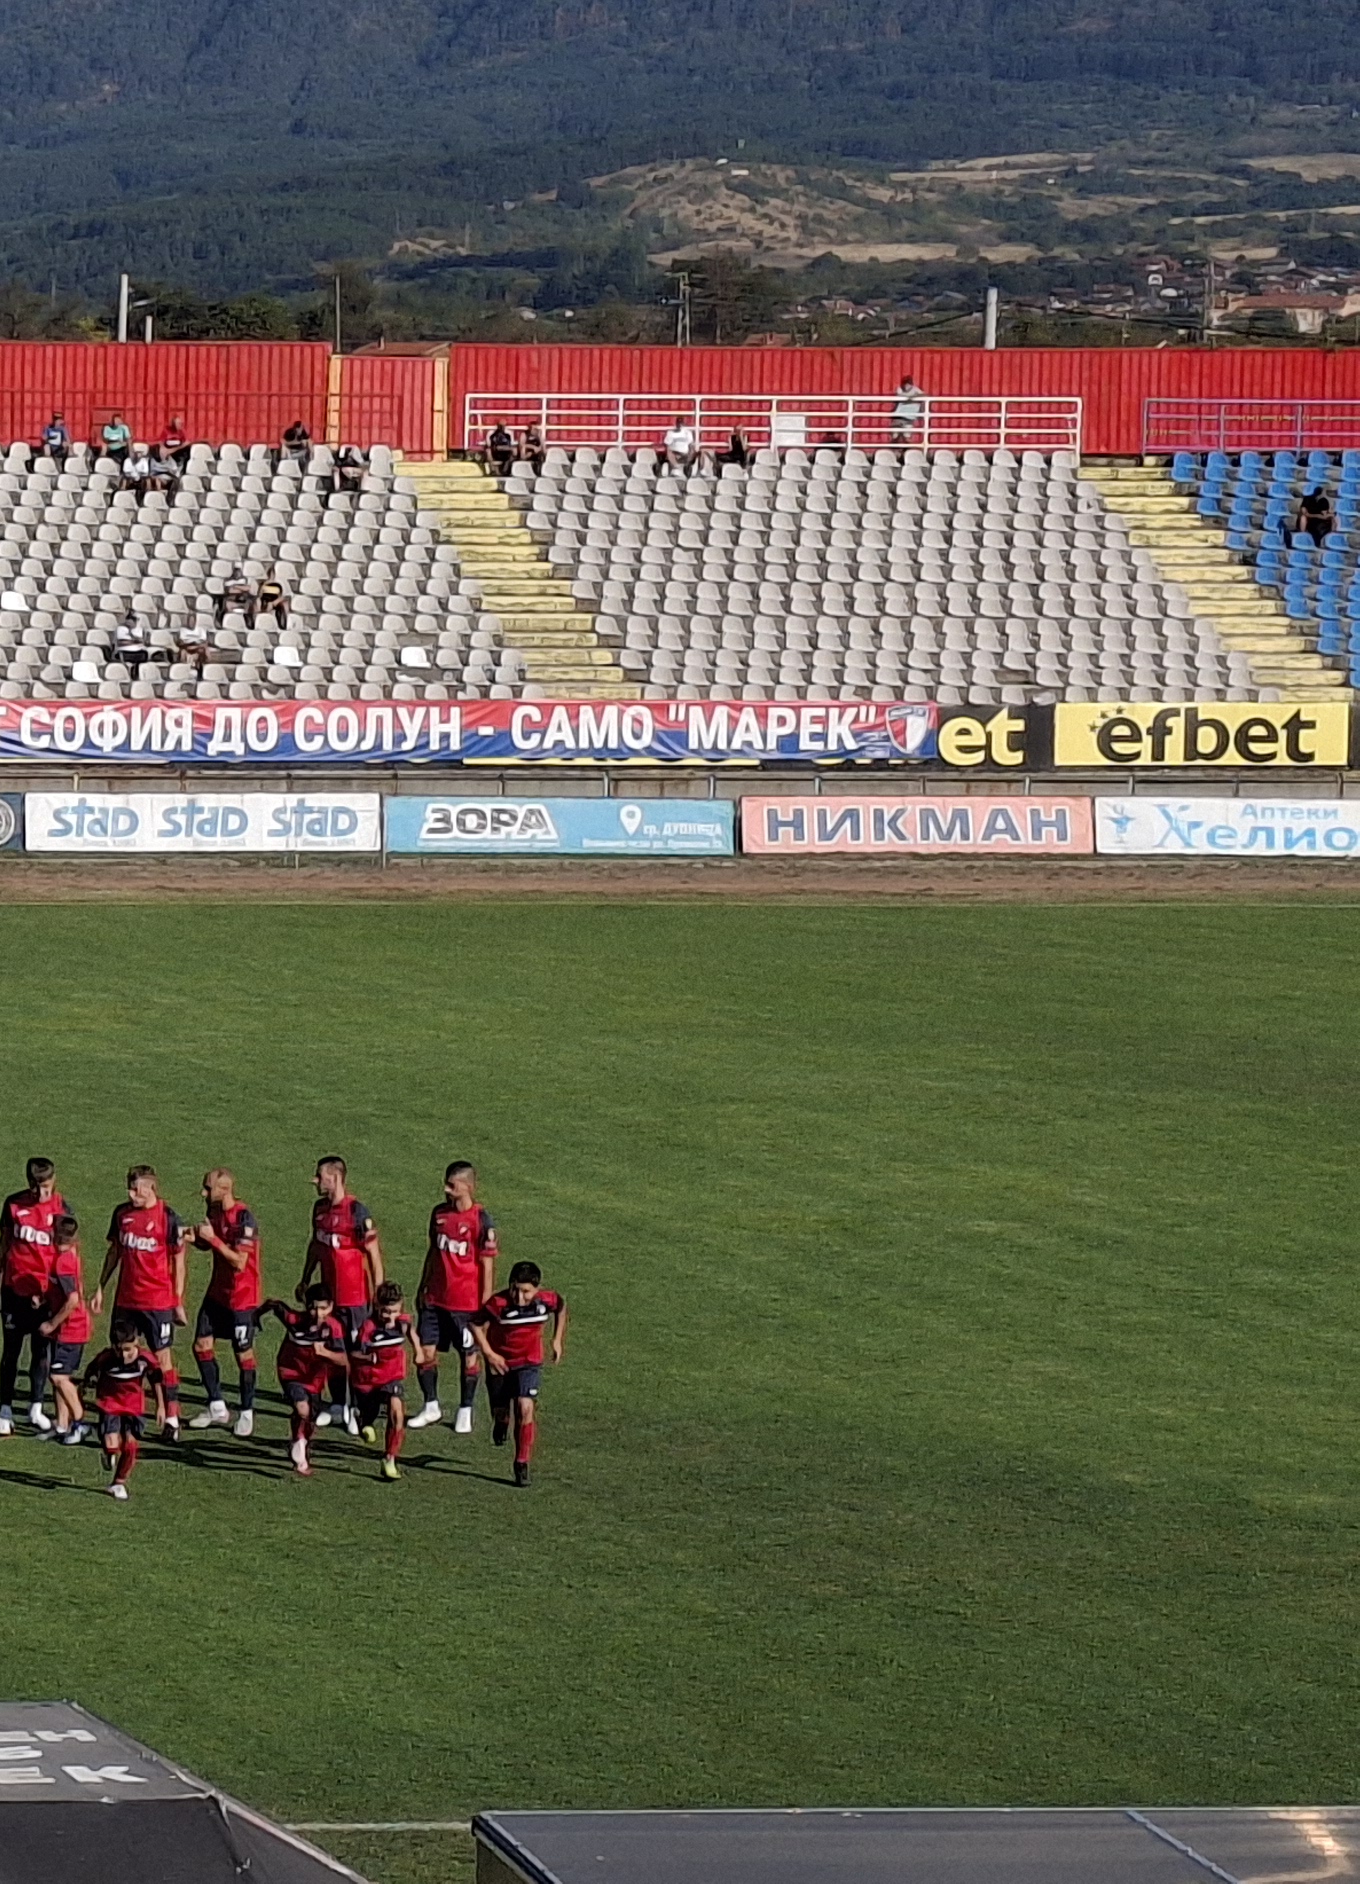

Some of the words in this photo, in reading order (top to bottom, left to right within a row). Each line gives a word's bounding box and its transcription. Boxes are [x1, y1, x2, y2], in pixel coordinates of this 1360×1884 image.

[20, 706, 192, 753] СОФИЯ
[208, 707, 278, 757] ДО
[294, 706, 462, 753] СОЛУН
[511, 705, 654, 750] САМО
[668, 704, 877, 751] "МАРЕК"
[1096, 706, 1317, 762] efbet
[425, 807, 552, 836] ЗОРА
[765, 807, 1071, 843] НИКМАН
[1241, 803, 1339, 821] Аптеки
